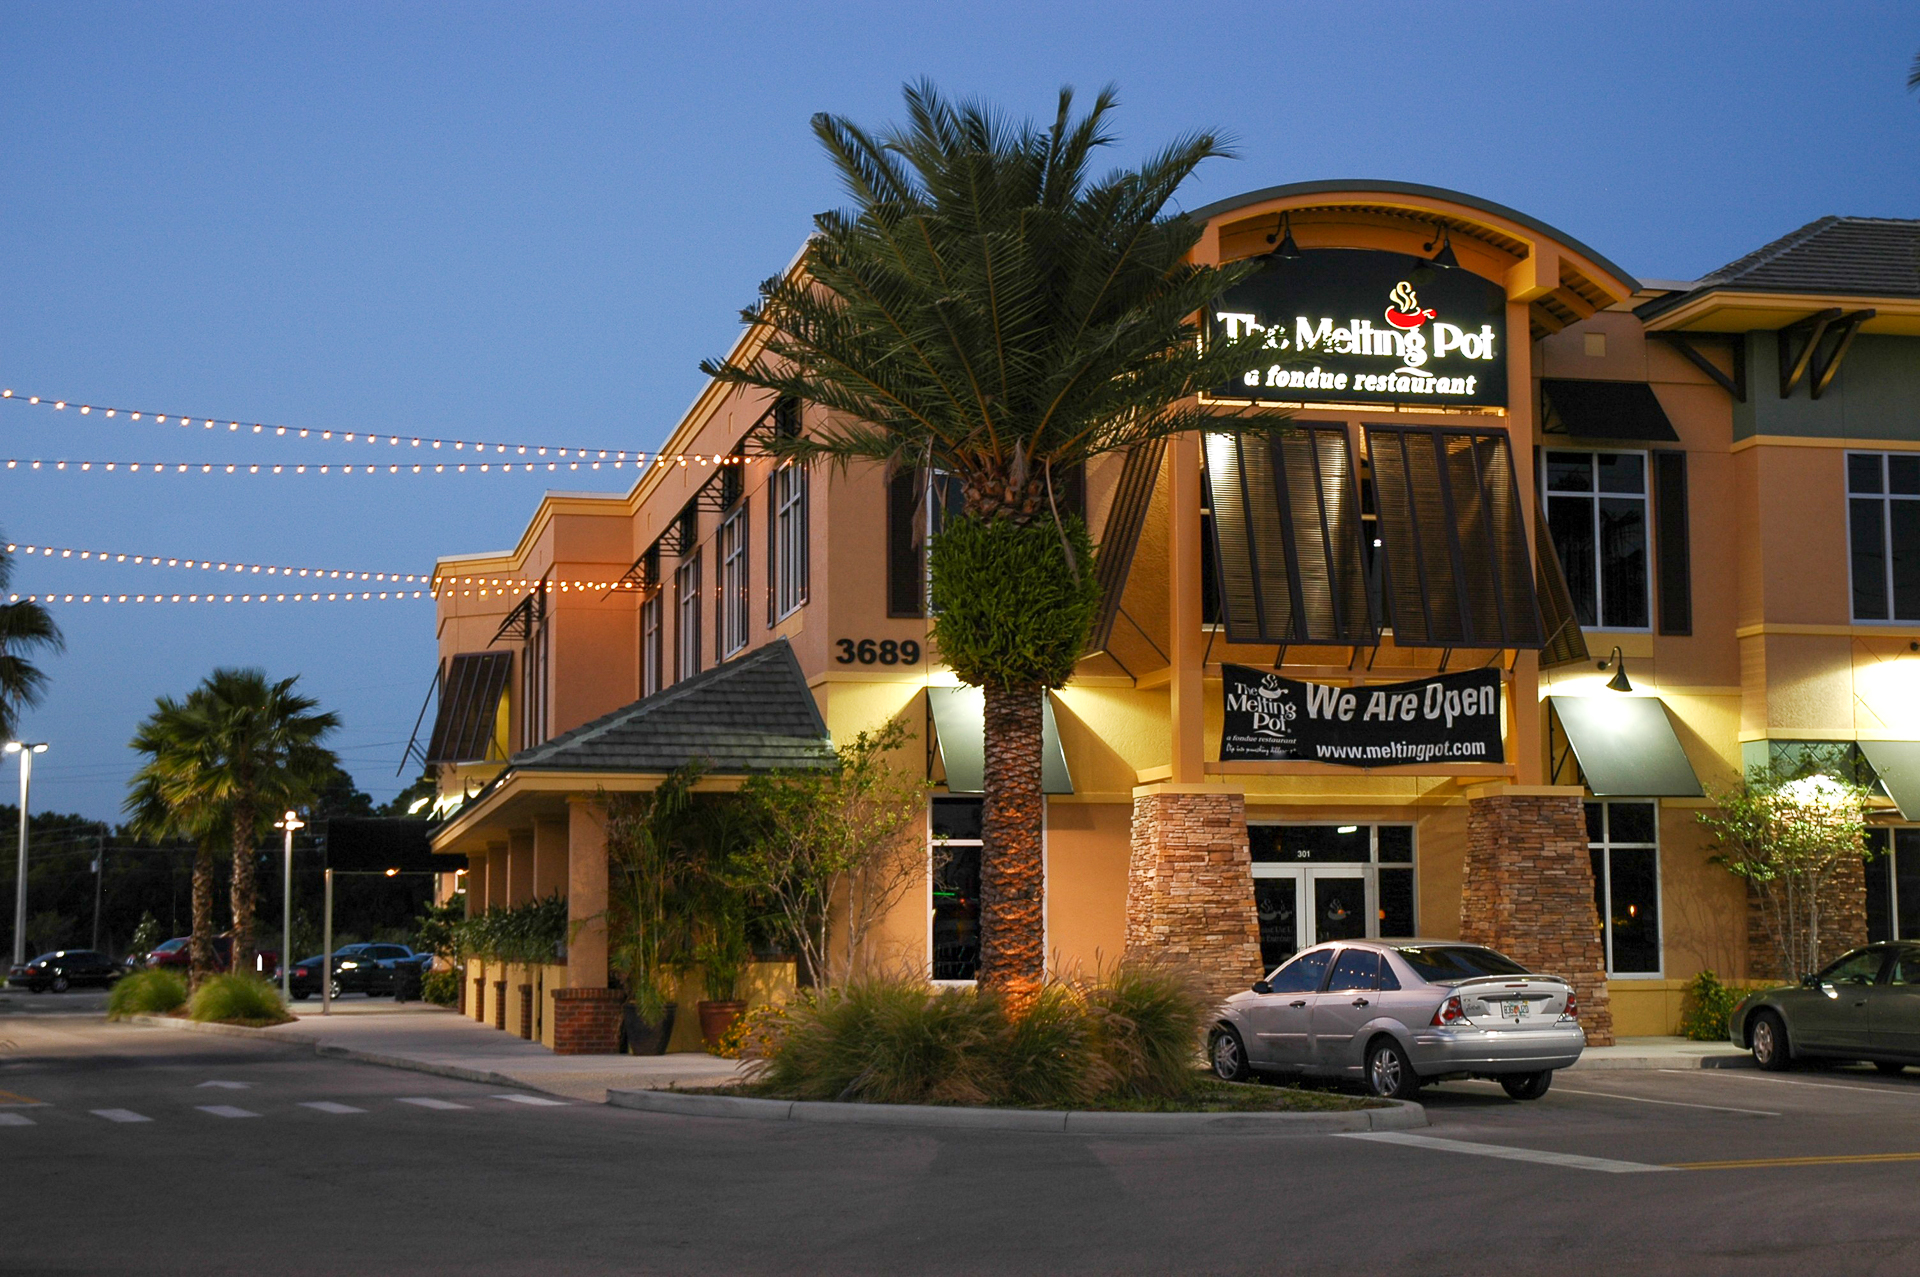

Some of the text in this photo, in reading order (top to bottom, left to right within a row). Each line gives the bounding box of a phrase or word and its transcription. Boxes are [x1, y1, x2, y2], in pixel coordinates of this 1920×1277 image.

[1295, 316, 1427, 367] Melting
[1433, 322, 1495, 360] Pot
[1244, 364, 1477, 395] a fondue restaurant
[835, 638, 920, 666] 3689
[1234, 682, 1258, 696] The
[1226, 693, 1297, 721] Melting
[1306, 682, 1495, 728] We Are Open
[1253, 712, 1286, 731] Pot
[1233, 734, 1258, 743] fondue
[1316, 741, 1486, 762] www.meltingpot.com
[1297, 850, 1311, 858] 301
